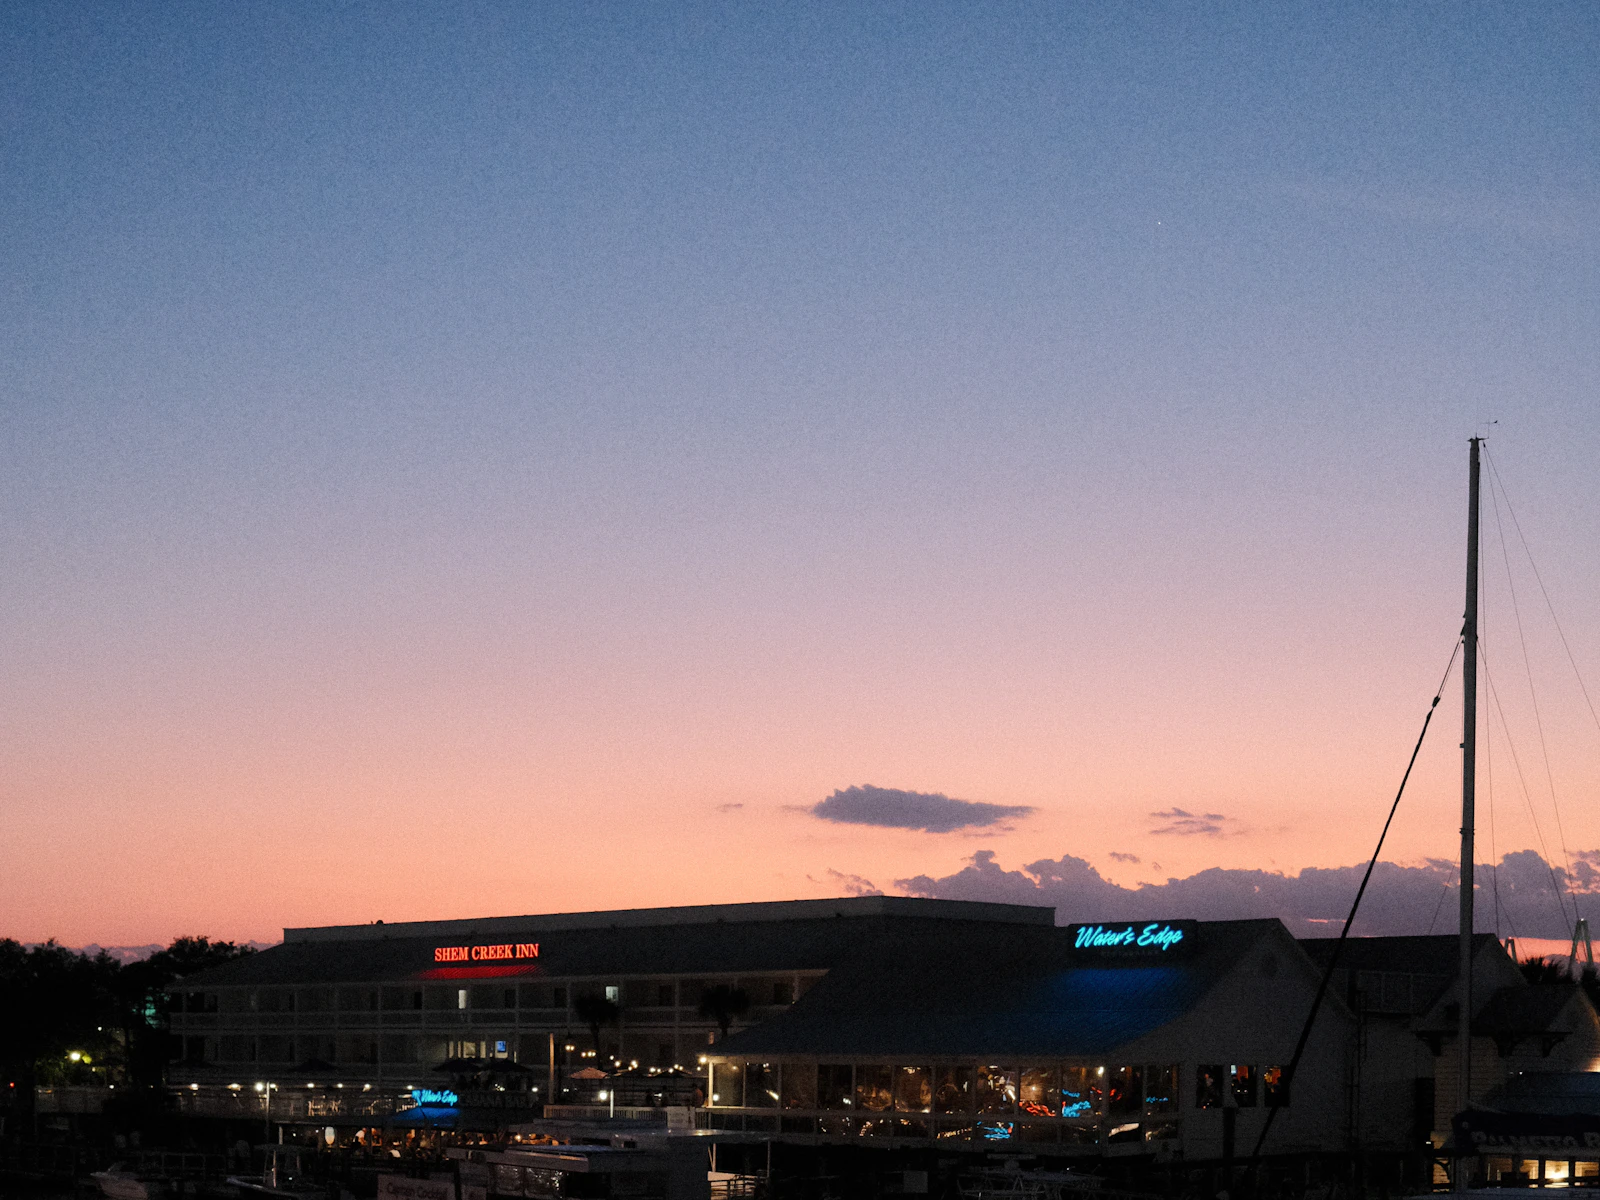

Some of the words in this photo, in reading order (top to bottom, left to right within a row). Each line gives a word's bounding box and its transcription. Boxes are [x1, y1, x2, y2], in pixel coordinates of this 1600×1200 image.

[1074, 925, 1135, 948] Water's
[1137, 923, 1184, 951] Edge
[434, 946, 469, 962] SHEM
[471, 944, 513, 960] CREEK
[515, 943, 539, 958] INN
